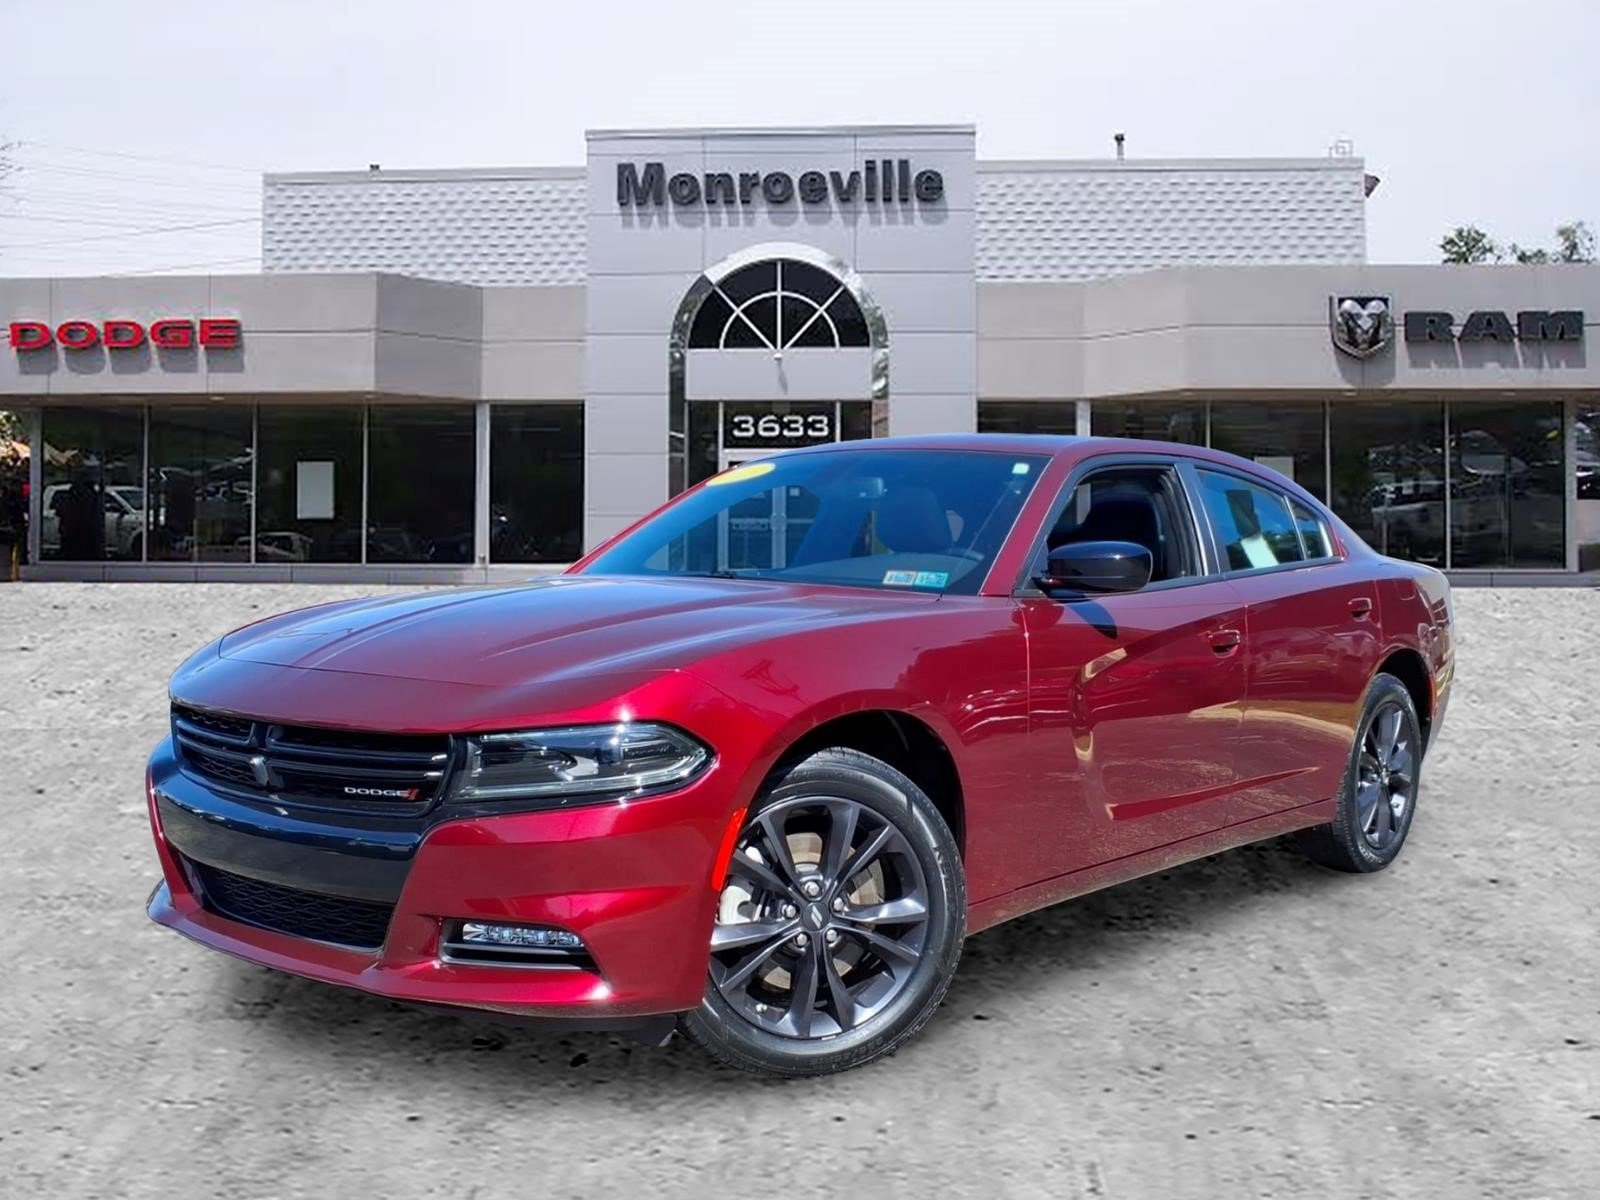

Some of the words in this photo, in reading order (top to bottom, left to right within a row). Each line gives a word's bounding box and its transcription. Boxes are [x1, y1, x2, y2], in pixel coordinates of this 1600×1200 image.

[616, 160, 945, 206] Monroeville
[9, 318, 241, 350] DODGE
[1404, 310, 1585, 342] RAM
[733, 416, 829, 438] 3633
[344, 786, 410, 797] DODGE
